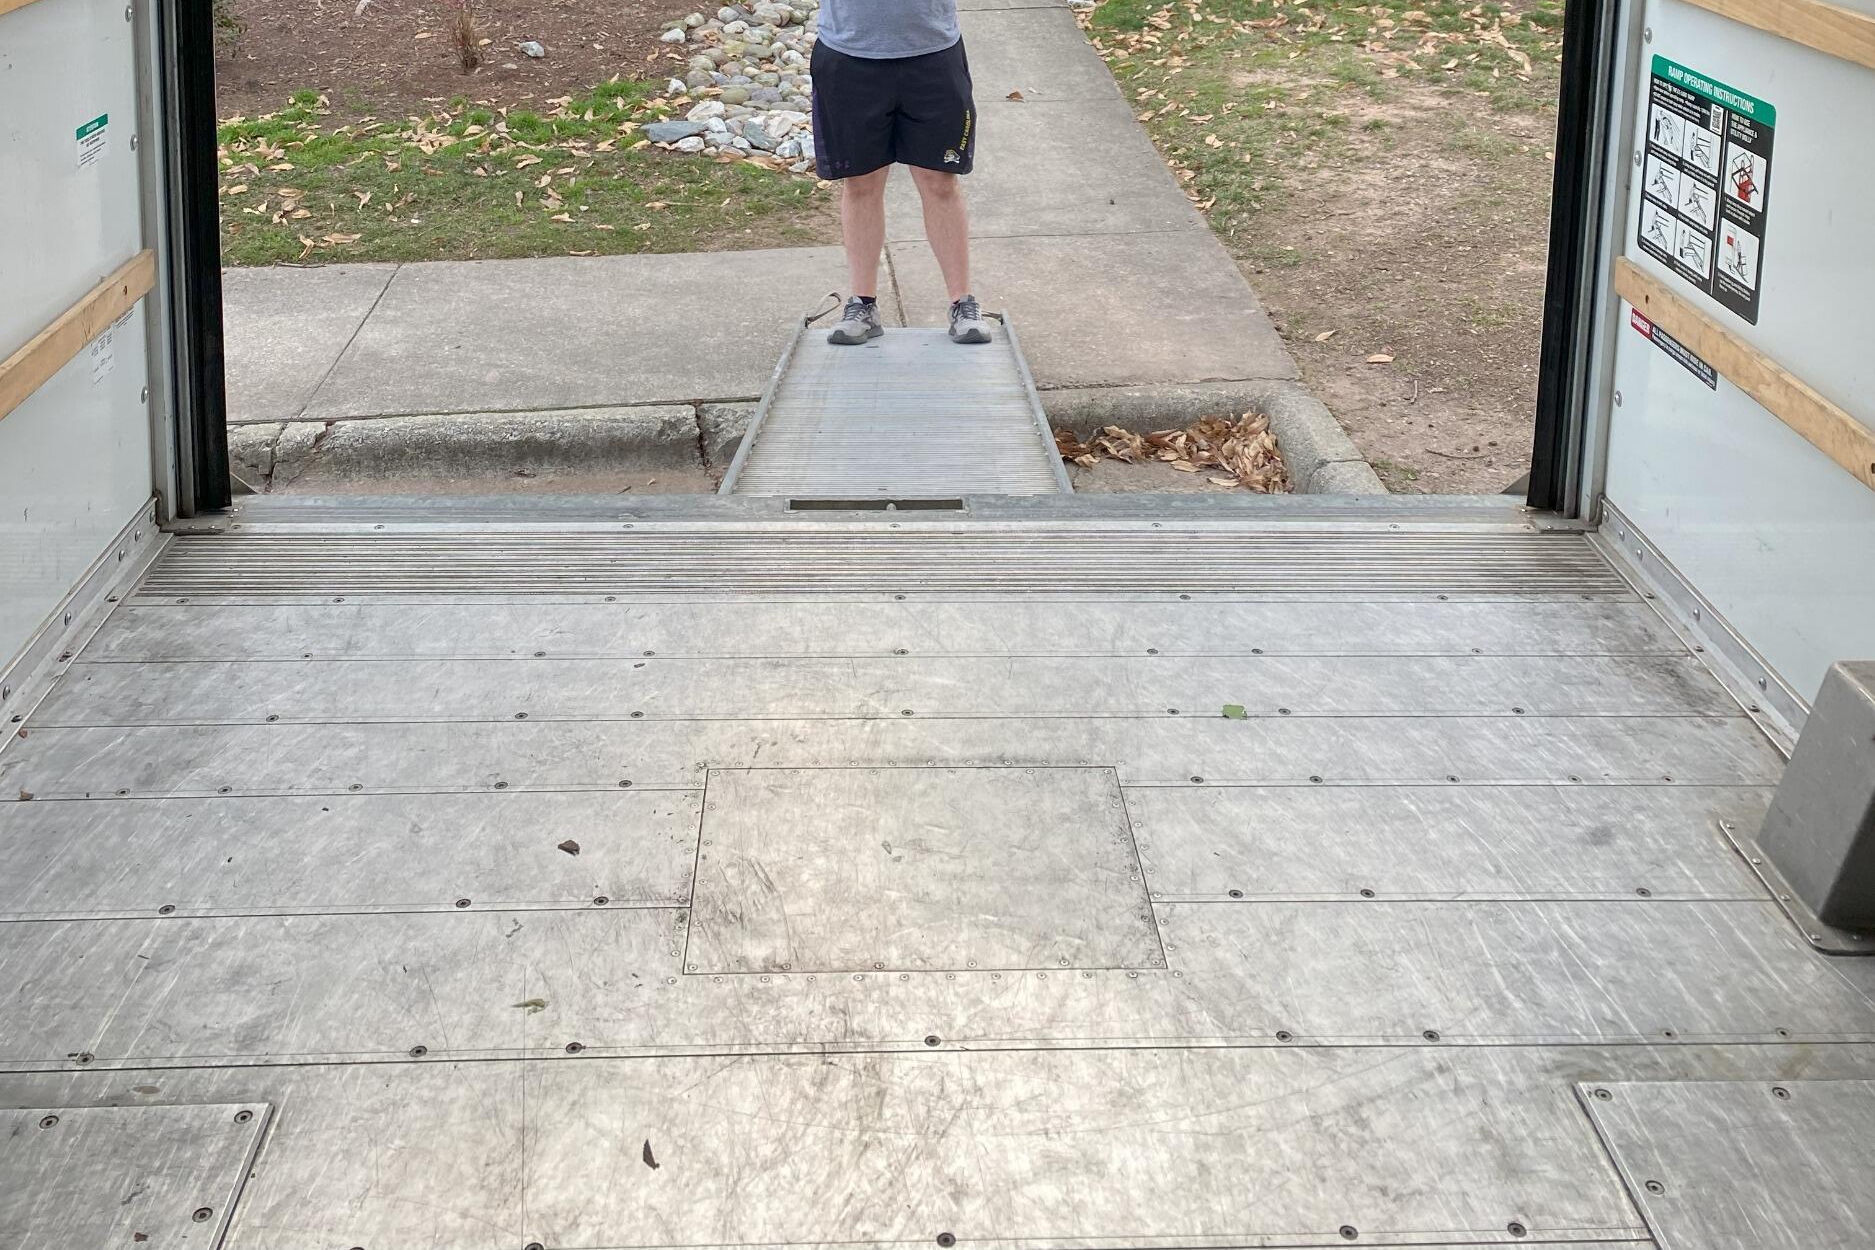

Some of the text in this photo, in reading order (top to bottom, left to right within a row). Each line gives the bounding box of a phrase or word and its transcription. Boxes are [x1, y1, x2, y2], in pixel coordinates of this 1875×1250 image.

[1668, 65, 1684, 81] RAMP
[1684, 70, 1713, 96] OPERATING
[1713, 84, 1755, 114] INSTRUCTIONS
